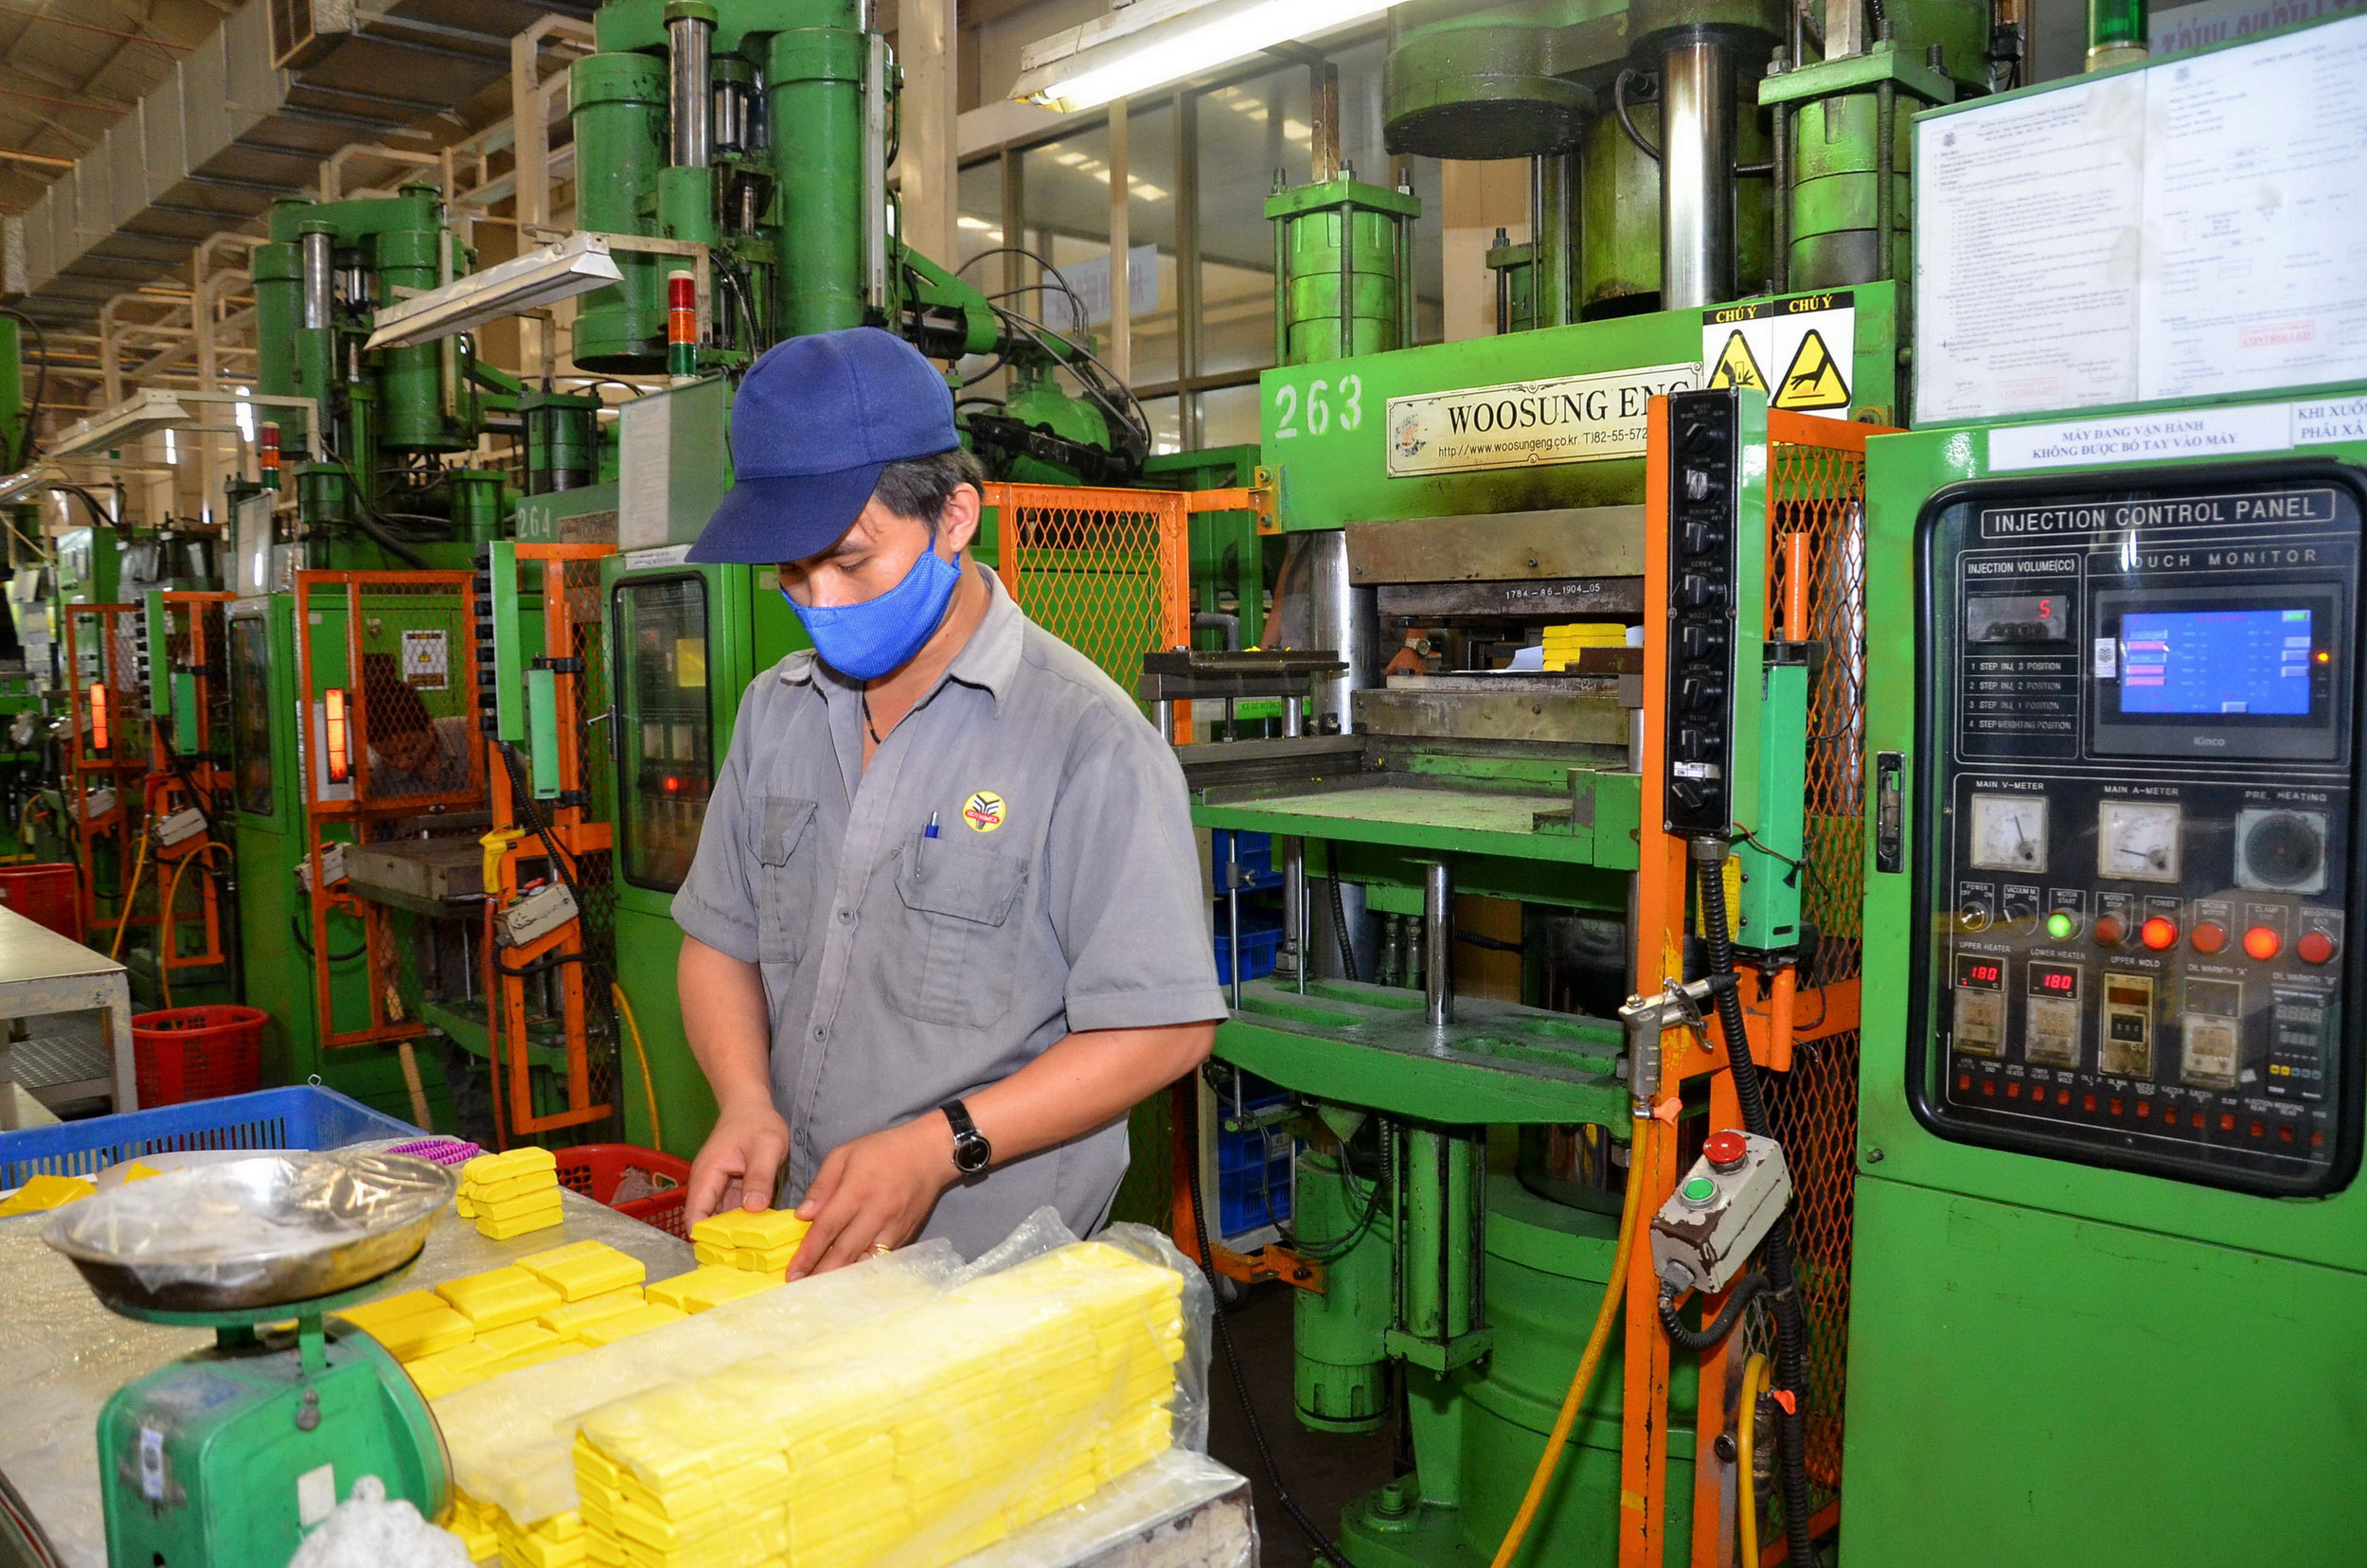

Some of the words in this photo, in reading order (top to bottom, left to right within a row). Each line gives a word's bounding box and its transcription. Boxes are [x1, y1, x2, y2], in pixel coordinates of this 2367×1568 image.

[1789, 295, 1820, 312] CHÚ
[1821, 294, 1833, 309] Ý
[1716, 306, 1744, 323] CHÚ
[1746, 305, 1757, 319] Ý
[1274, 374, 1362, 438] 263
[1448, 388, 1609, 436] WOOSUNG
[1618, 382, 1689, 419] EN
[2299, 406, 2324, 419] KHI
[2329, 398, 2367, 417] XUỐ
[2094, 426, 2130, 440] ĐANG
[2165, 419, 2203, 434] HÀNH
[2302, 421, 2337, 438] PHẢI
[2033, 442, 2077, 459] KHÔNG
[2082, 441, 2119, 456] ĐƯỢC
[2144, 438, 2169, 451] TAY
[2205, 431, 2237, 445] MÁY
[1995, 508, 2105, 532] INJECTION
[2115, 503, 2224, 526] CONTROL
[2236, 497, 2316, 519] PANEL
[518, 506, 550, 538] 264
[2119, 554, 2190, 569] OUCH
[2209, 549, 2316, 565] MONITOR
[1968, 562, 2014, 574] INJECTION
[2018, 559, 2074, 572] VOLUME(CC)
[2038, 599, 2051, 618] 5
[1980, 662, 1998, 670] STEP
[2018, 662, 2024, 670] 3
[2027, 662, 2061, 670] POSITION
[1980, 682, 1998, 690] STEP
[2026, 682, 2061, 690] POSITION
[1969, 701, 1975, 709] 3
[1979, 701, 1998, 709] STEP
[2025, 702, 2059, 710] POSITION
[1979, 720, 1998, 728] STEP
[2037, 722, 2072, 730] POSITION
[2194, 736, 2227, 747] Kinco
[1976, 780, 1998, 789] MAIN
[2002, 781, 2045, 790] V-METER
[2104, 785, 2128, 793] MAIN
[2132, 786, 2179, 795] A-METER
[2276, 791, 2327, 802] HEATING
[2151, 899, 2176, 907] POWER
[1959, 941, 1982, 952] UPPER
[1984, 942, 2012, 953] HEATER
[2030, 948, 2056, 957] LOWER
[2058, 950, 2086, 960] HEATER
[2110, 956, 2135, 966] UPPER
[2139, 957, 2161, 967] MOLD
[1970, 967, 1998, 981] 180
[2201, 965, 2234, 974] WARMTH
[2043, 974, 2073, 989] 180
